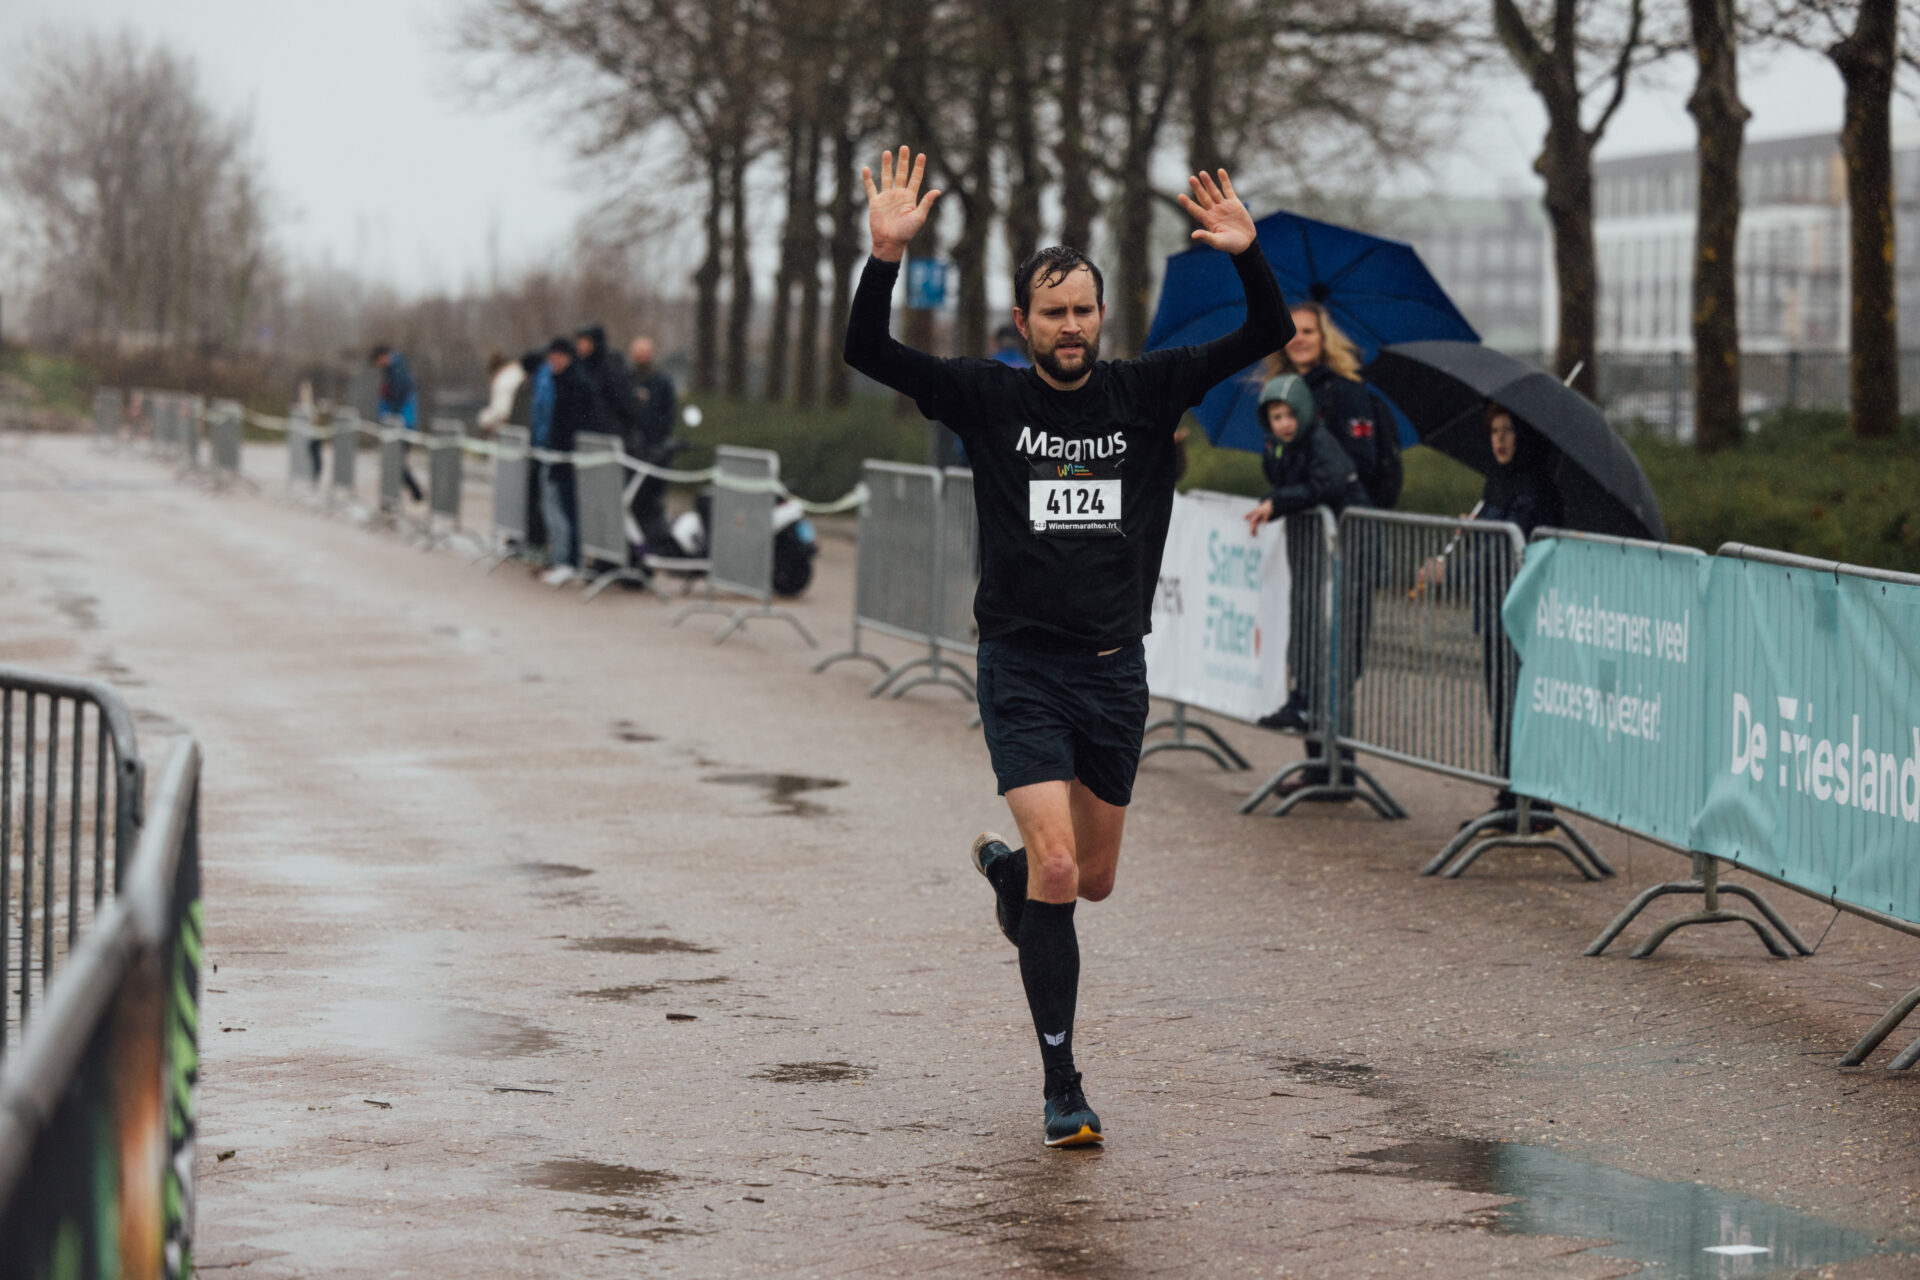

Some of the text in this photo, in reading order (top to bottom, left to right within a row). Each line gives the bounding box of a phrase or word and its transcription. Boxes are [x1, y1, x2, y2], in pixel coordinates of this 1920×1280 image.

[1016, 426, 1127, 462] Magnus
[1046, 488, 1105, 514] 4124
[1656, 609, 1690, 664] veel
[1532, 676, 1583, 722] succes
[1731, 692, 1768, 782] De
